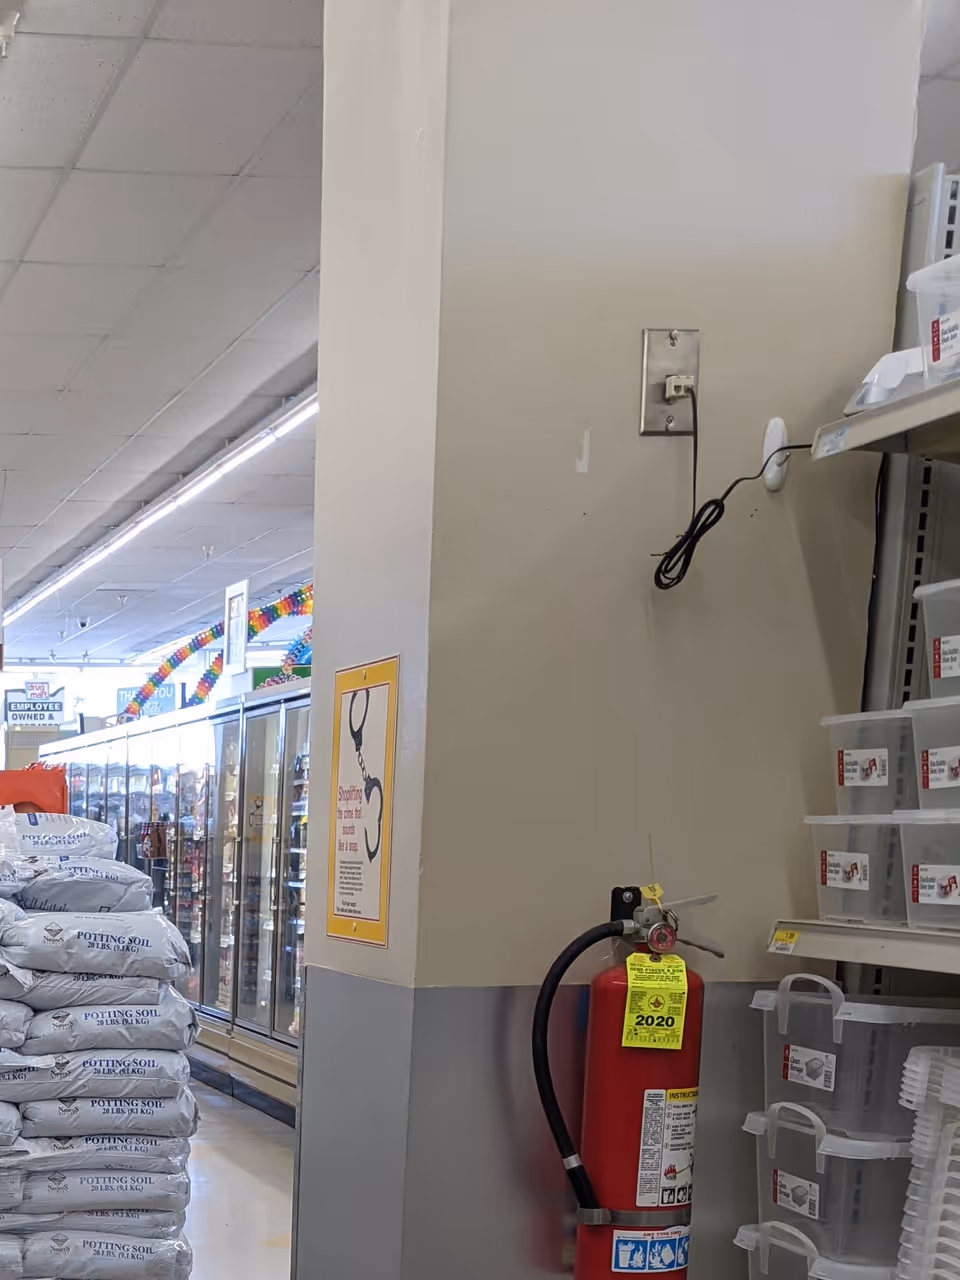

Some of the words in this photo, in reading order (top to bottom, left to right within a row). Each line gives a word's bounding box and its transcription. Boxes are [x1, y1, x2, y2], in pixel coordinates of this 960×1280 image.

[27, 684, 45, 692] drug
[11, 703, 61, 711] EMPLOYEE
[12, 713, 45, 721] OWNED
[48, 713, 55, 721] &
[338, 786, 362, 804] Shoplifting
[77, 931, 125, 945] POTTING
[127, 935, 152, 949] SOIL
[84, 1010, 133, 1020] POTTING
[135, 1009, 161, 1017] SOIL
[635, 1015, 675, 1027] 2020
[82, 1059, 130, 1068] POTTING
[132, 1059, 159, 1068] SOIL
[90, 1100, 139, 1108] POTTING
[140, 1100, 165, 1109] SOIL
[80, 1176, 128, 1185] POTTING
[130, 1177, 155, 1185] SOIL
[83, 1240, 129, 1252] POTTING
[132, 1245, 156, 1255] SOIL
